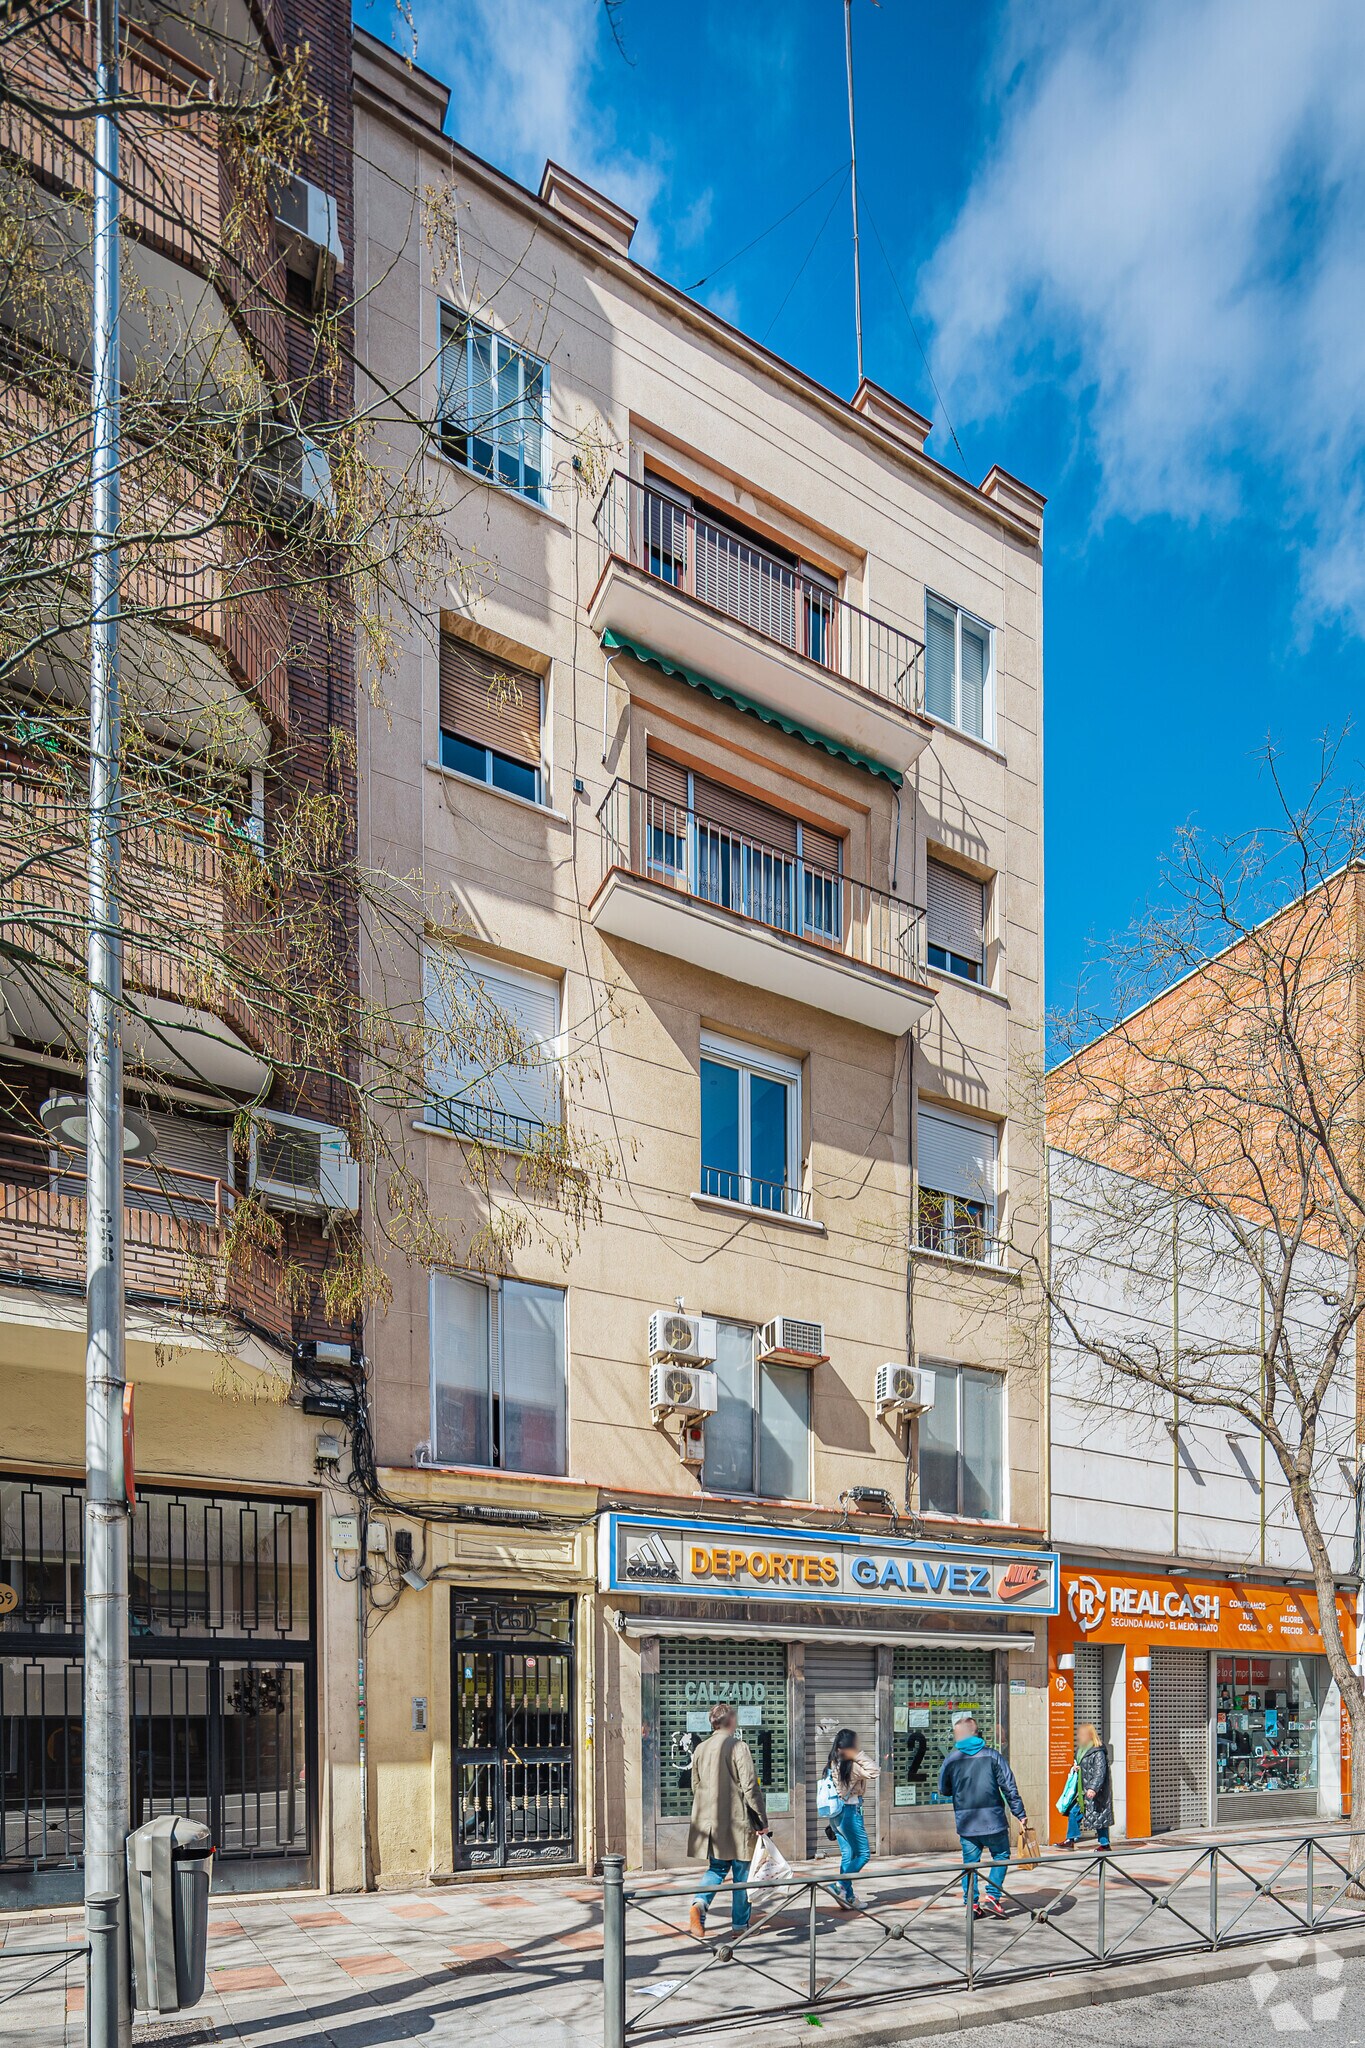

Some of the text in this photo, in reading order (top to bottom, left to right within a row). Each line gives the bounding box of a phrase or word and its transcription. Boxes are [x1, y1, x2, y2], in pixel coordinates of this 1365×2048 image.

[626, 1564, 678, 1579] adidas
[690, 1547, 837, 1582] DEPORTES
[851, 1556, 990, 1592] GALVEZ
[1005, 1563, 1039, 1583] NIKE
[1110, 1587, 1220, 1620] REALCASH
[1229, 1600, 1266, 1610] COMPRAMOS
[1286, 1605, 1297, 1613] LOS
[1242, 1612, 1253, 1621] TUS
[1280, 1615, 1304, 1624] MEJORES
[1111, 1617, 1219, 1633] SEGUNDA MANO EL MEJOR TRATO
[1238, 1624, 1257, 1632] COSAS
[1280, 1626, 1303, 1635] PRECIOS
[685, 1682, 766, 1701] CALZADO
[912, 1679, 977, 1697] CALZADO
